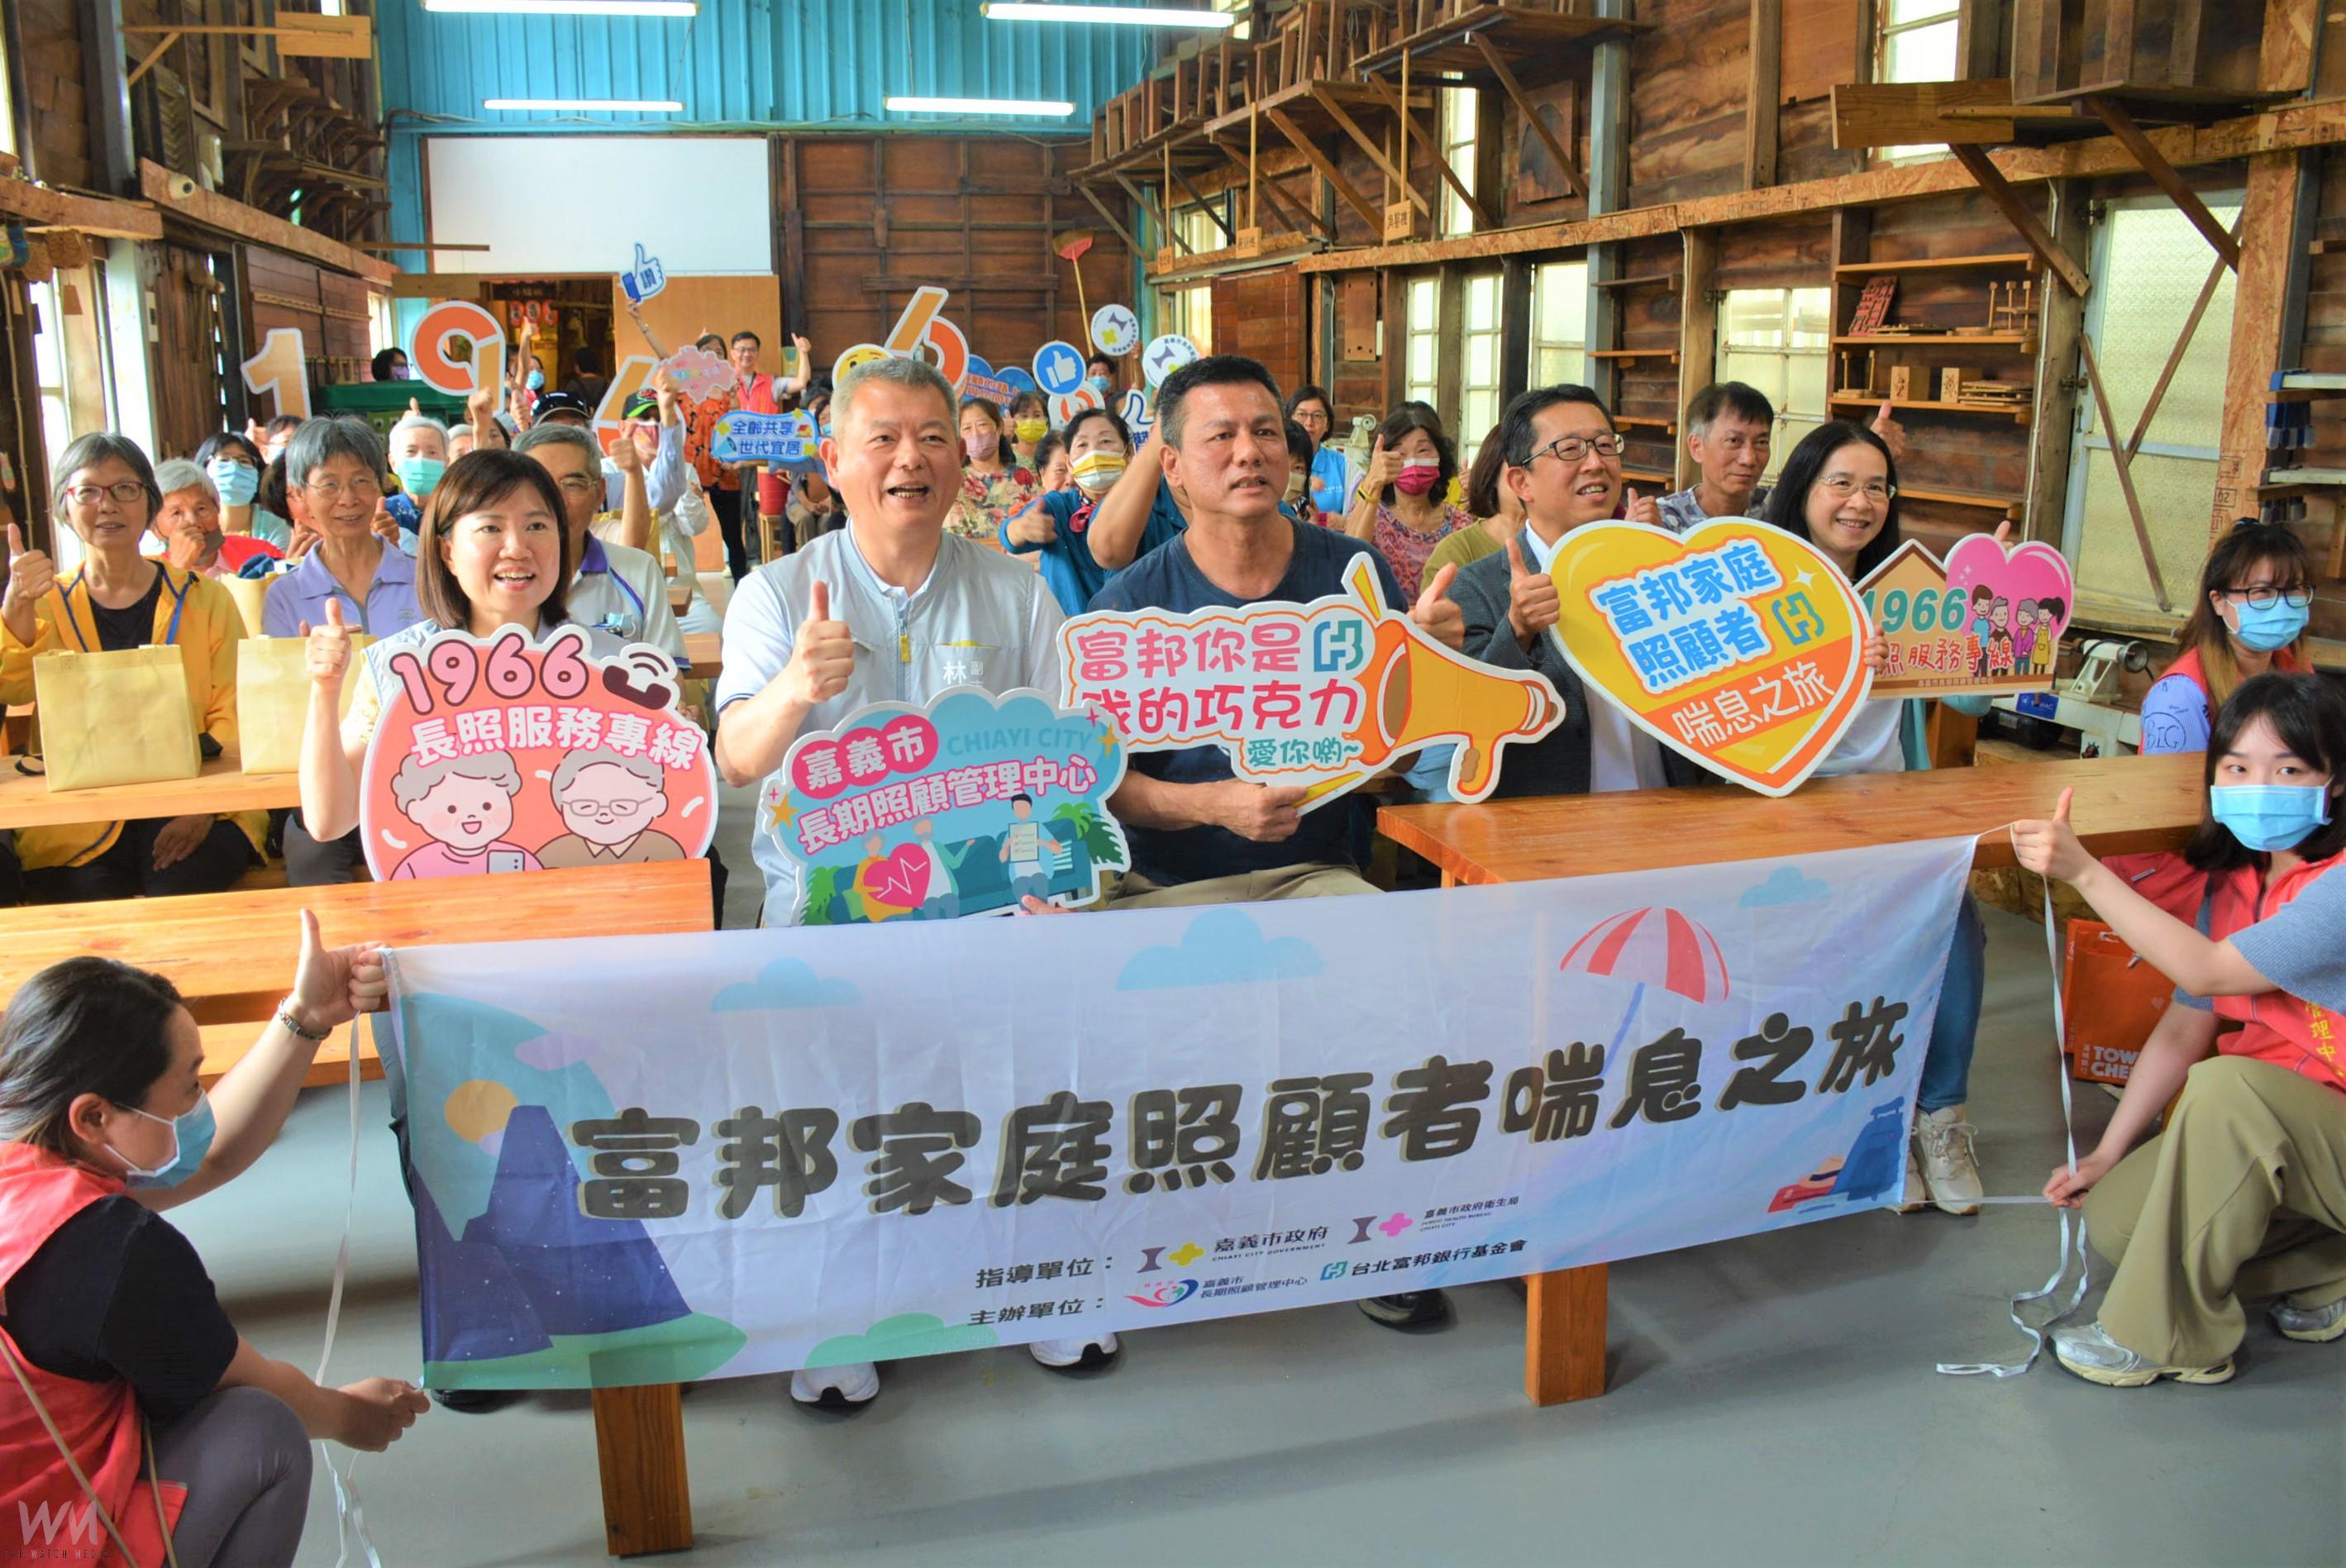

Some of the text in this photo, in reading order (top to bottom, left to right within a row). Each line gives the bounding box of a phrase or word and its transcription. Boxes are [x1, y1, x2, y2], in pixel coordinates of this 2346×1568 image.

[732, 420, 794, 436] 全齡共享
[739, 439, 801, 455] 世代宜居
[1596, 544, 1777, 636] 富邦家庭
[1863, 588, 1968, 634] 1966
[1077, 621, 1302, 682] 富邦你是
[1627, 606, 1766, 688] 照顧者
[1876, 634, 2015, 677] 照服務專線
[389, 632, 589, 716] 1966
[942, 660, 967, 685] 林
[1081, 679, 1359, 735] 我的巧克力
[1671, 660, 1837, 748] 喘息之旅
[412, 705, 703, 771] 長照服務專線
[799, 725, 927, 791] 嘉義市
[946, 726, 1094, 756] CHIAYI CITY
[799, 755, 1098, 855] 長期照顧管理中心
[2091, 1061, 2131, 1079] CHE
[2093, 1045, 2139, 1065] TOW
[569, 995, 1911, 1223] 富邦家庭照顧者喘息之旅
[1423, 1196, 1519, 1219] 嘉義市政府衛生局
[1212, 1253, 1242, 1262] CHIAYI
[1267, 1242, 1326, 1255] GOVERNMENT
[1214, 1225, 1329, 1253] 嘉義市政府
[1351, 1238, 1528, 1277] 台北富邦銀行基金會
[1200, 1276, 1308, 1299] 長期照顧管理中心
[1203, 1275, 1245, 1289] 嘉義市
